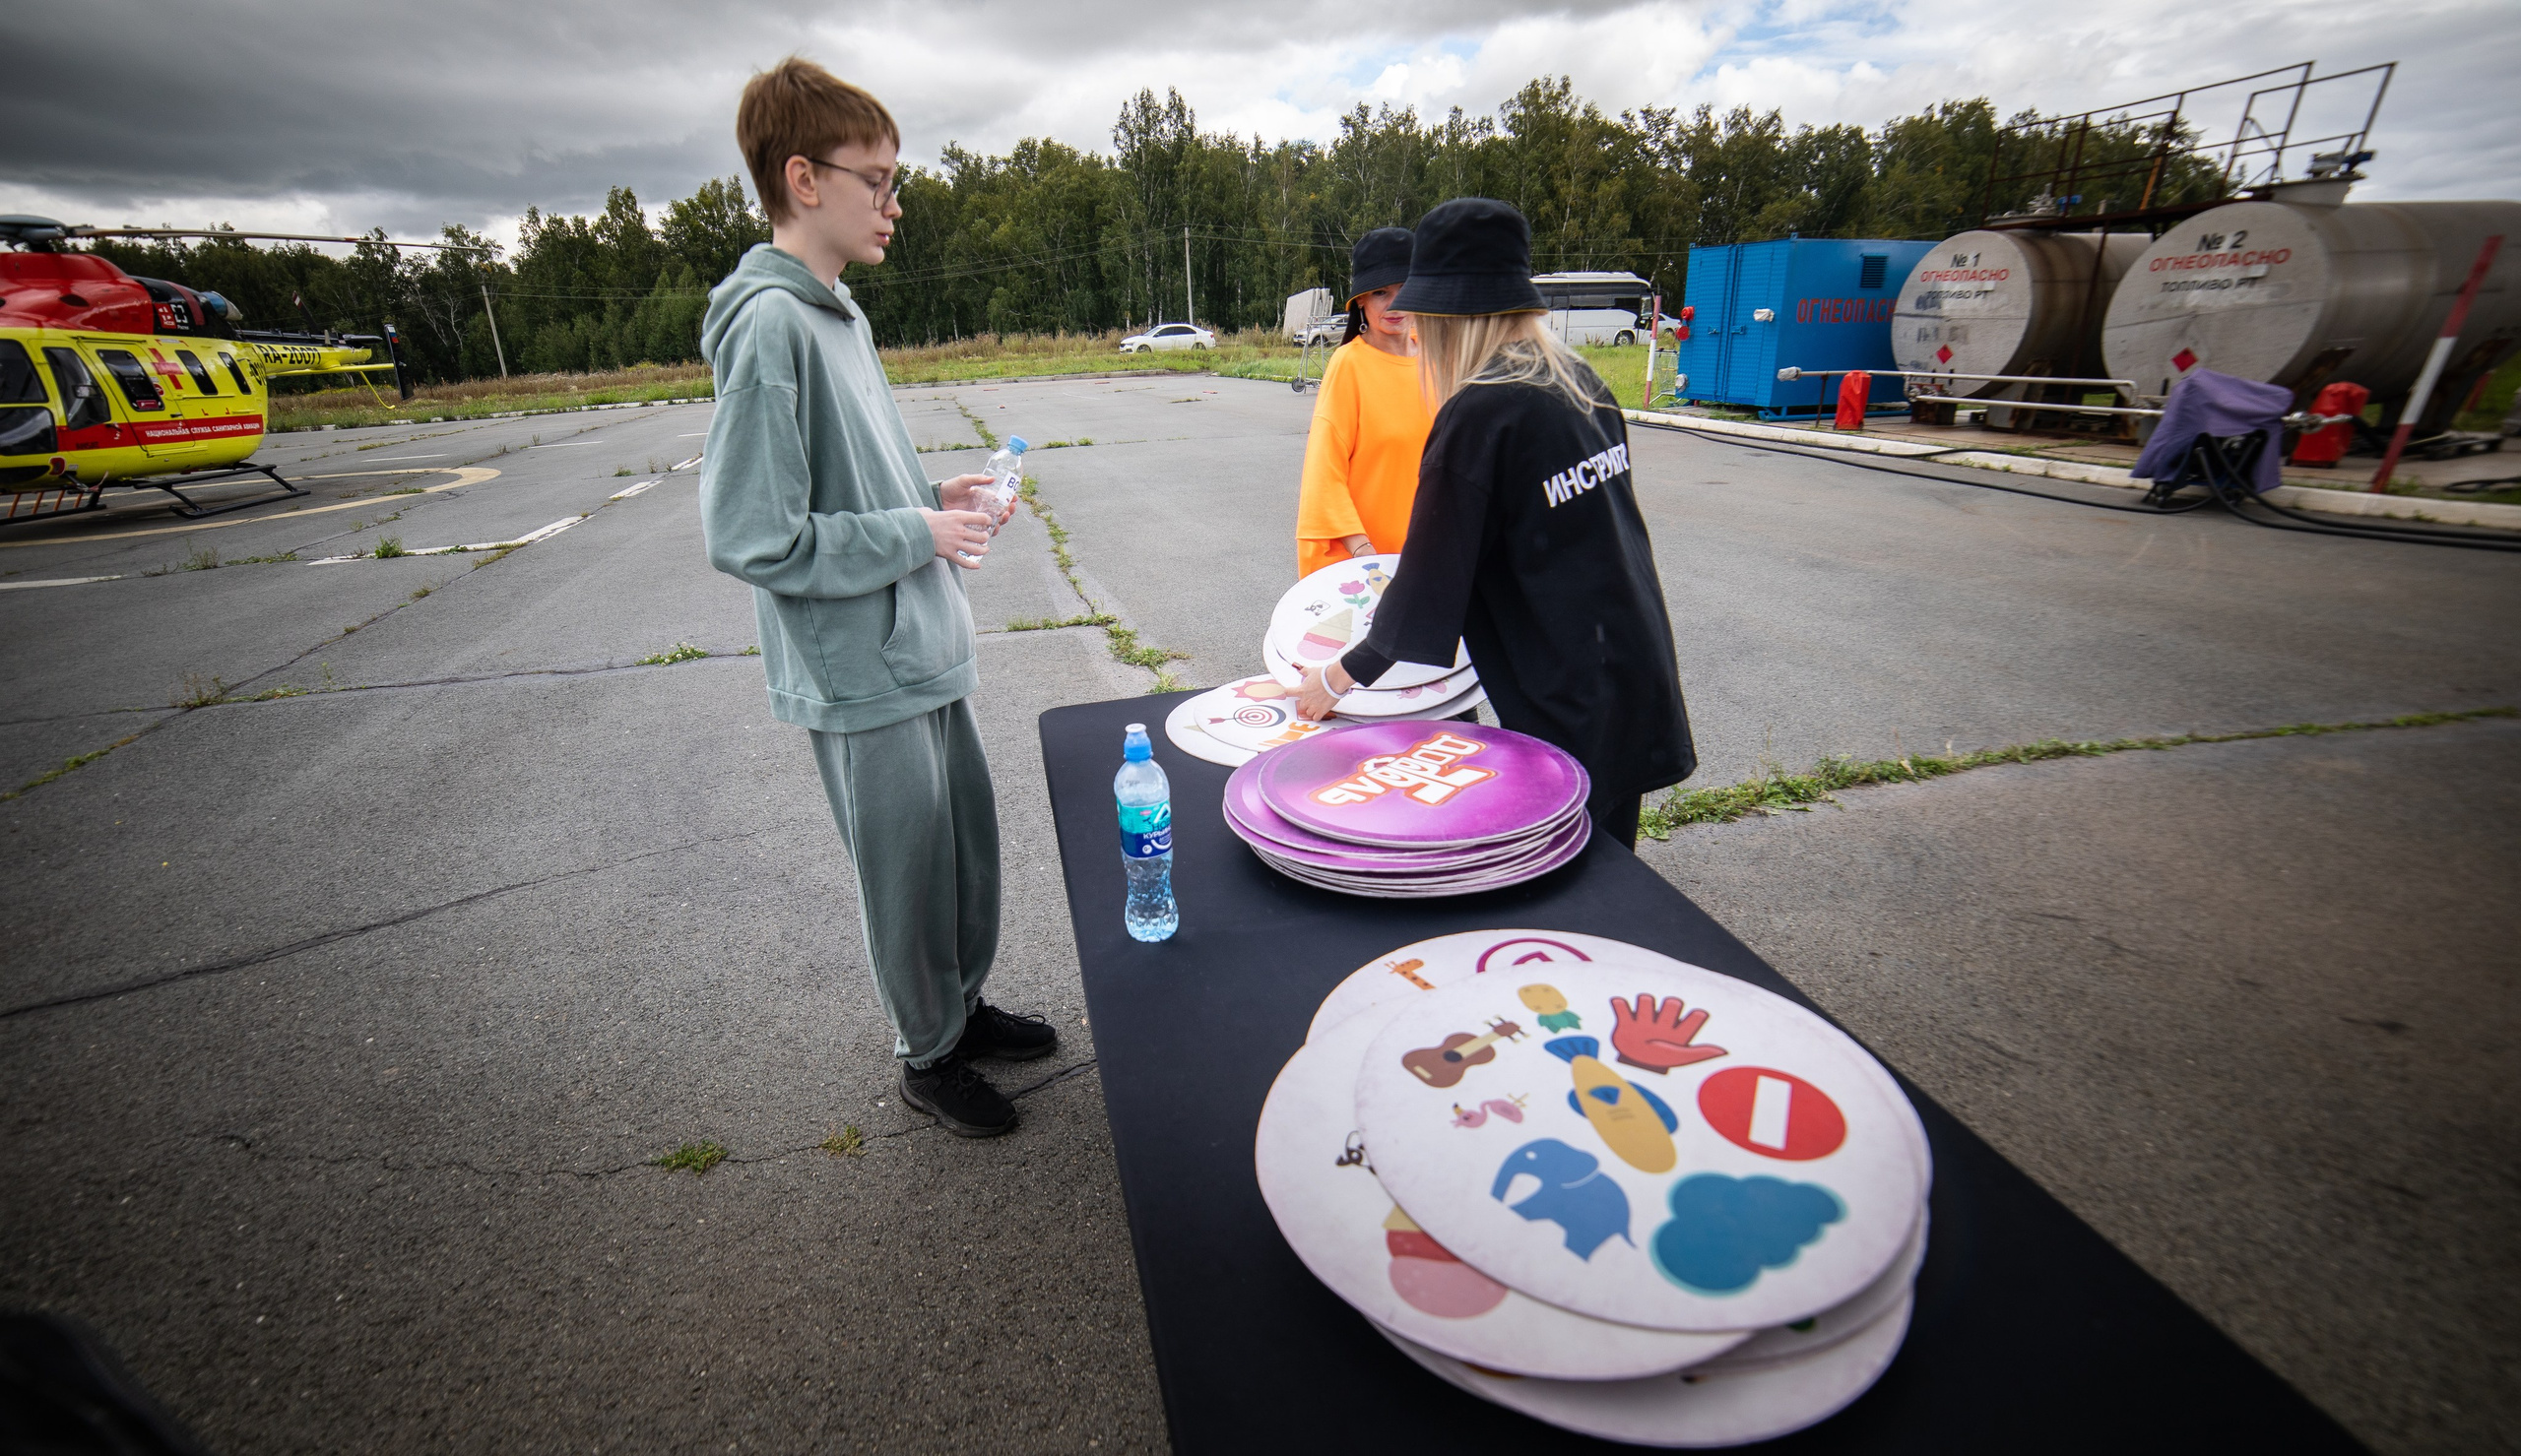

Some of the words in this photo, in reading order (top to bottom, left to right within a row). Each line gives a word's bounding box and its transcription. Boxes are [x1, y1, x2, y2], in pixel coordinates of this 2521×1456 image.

[2229, 229, 2248, 250] 2
[1972, 252, 1981, 267] 1
[2149, 248, 2292, 272] ОГНЕОПАСНО
[1920, 269, 2009, 283] ОГНЕОПАСНО
[1796, 298, 1898, 323] ОГНЕОПАСН
